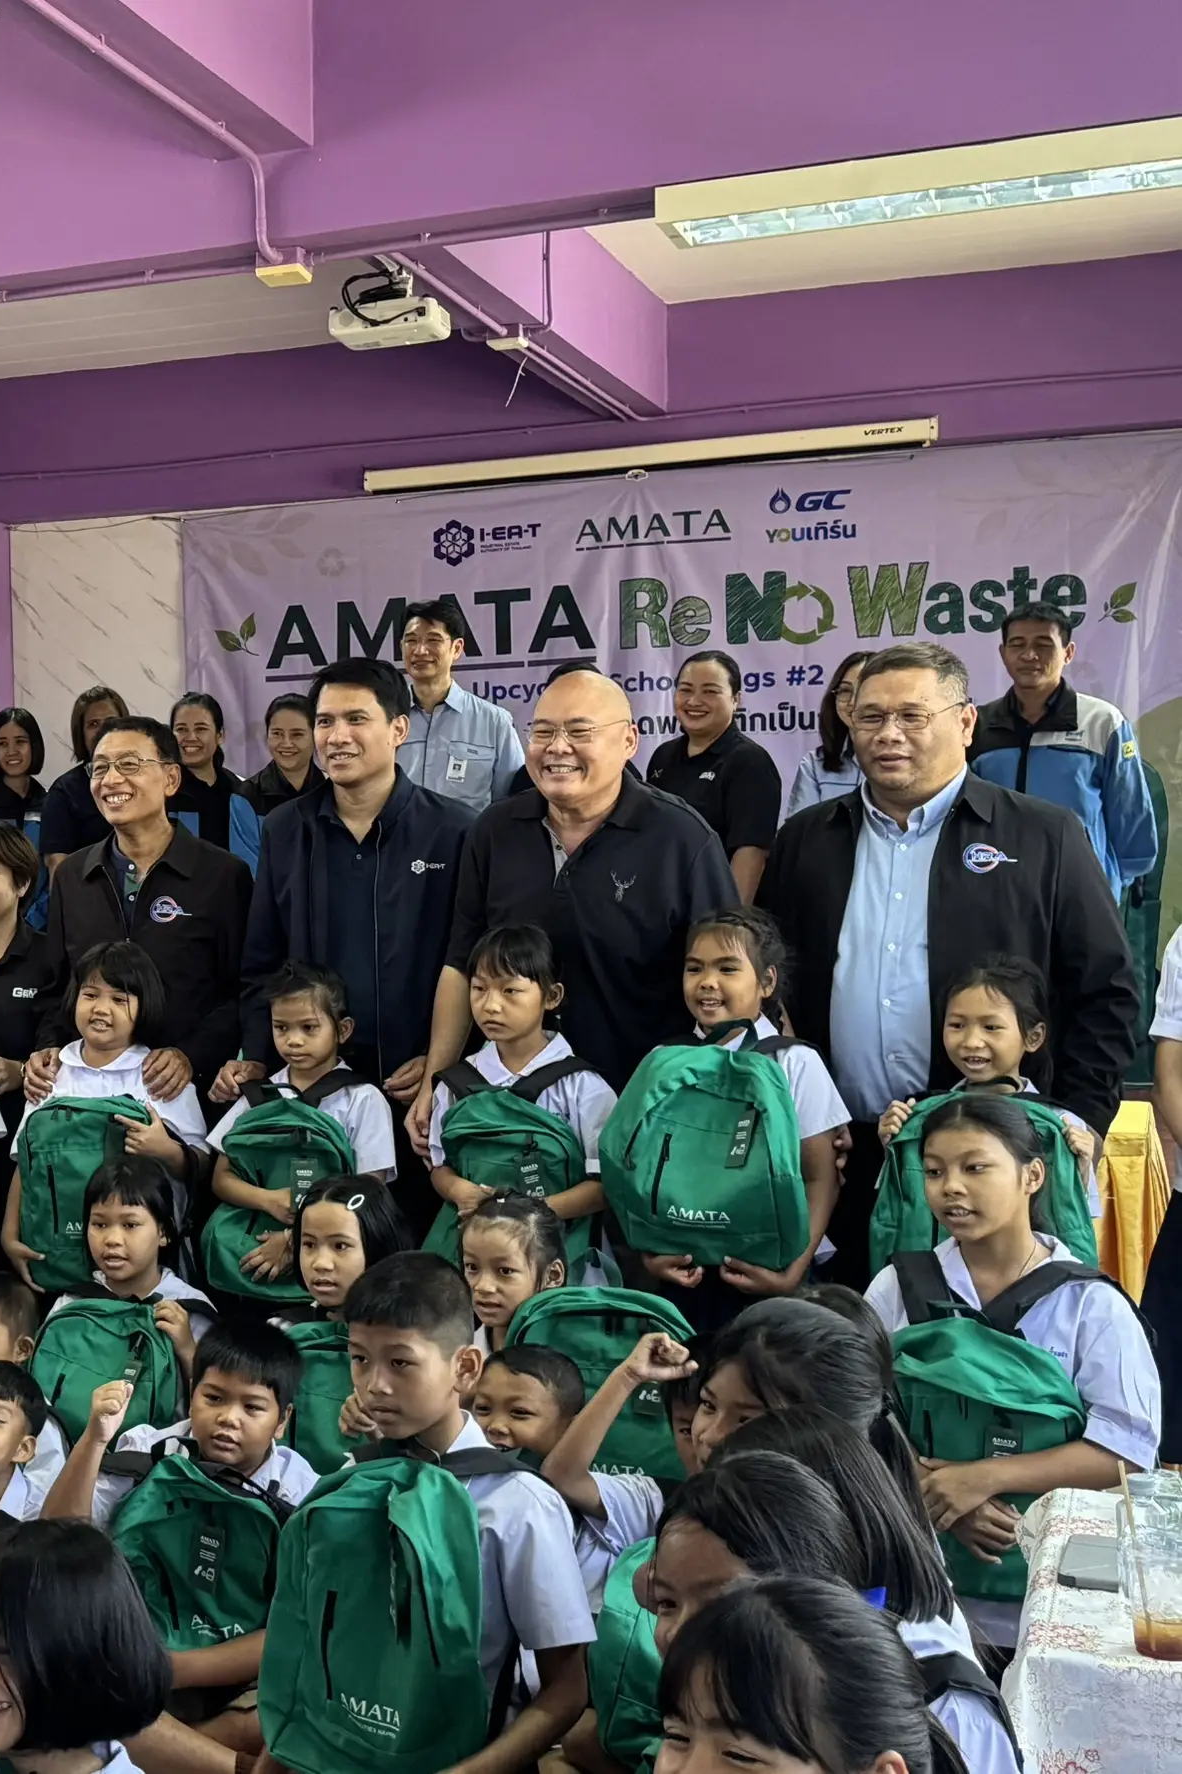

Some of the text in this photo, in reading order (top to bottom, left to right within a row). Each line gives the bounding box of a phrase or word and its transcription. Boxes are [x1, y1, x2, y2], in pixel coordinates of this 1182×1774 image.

[864, 426, 904, 436] VERTEX
[795, 489, 852, 513] GC
[576, 508, 732, 545] AMATA
[618, 575, 713, 650] Re
[786, 664, 824, 687] #2
[667, 1205, 730, 1221] AMATA
[592, 1463, 645, 1476] MATA
[191, 1614, 245, 1639] ATA
